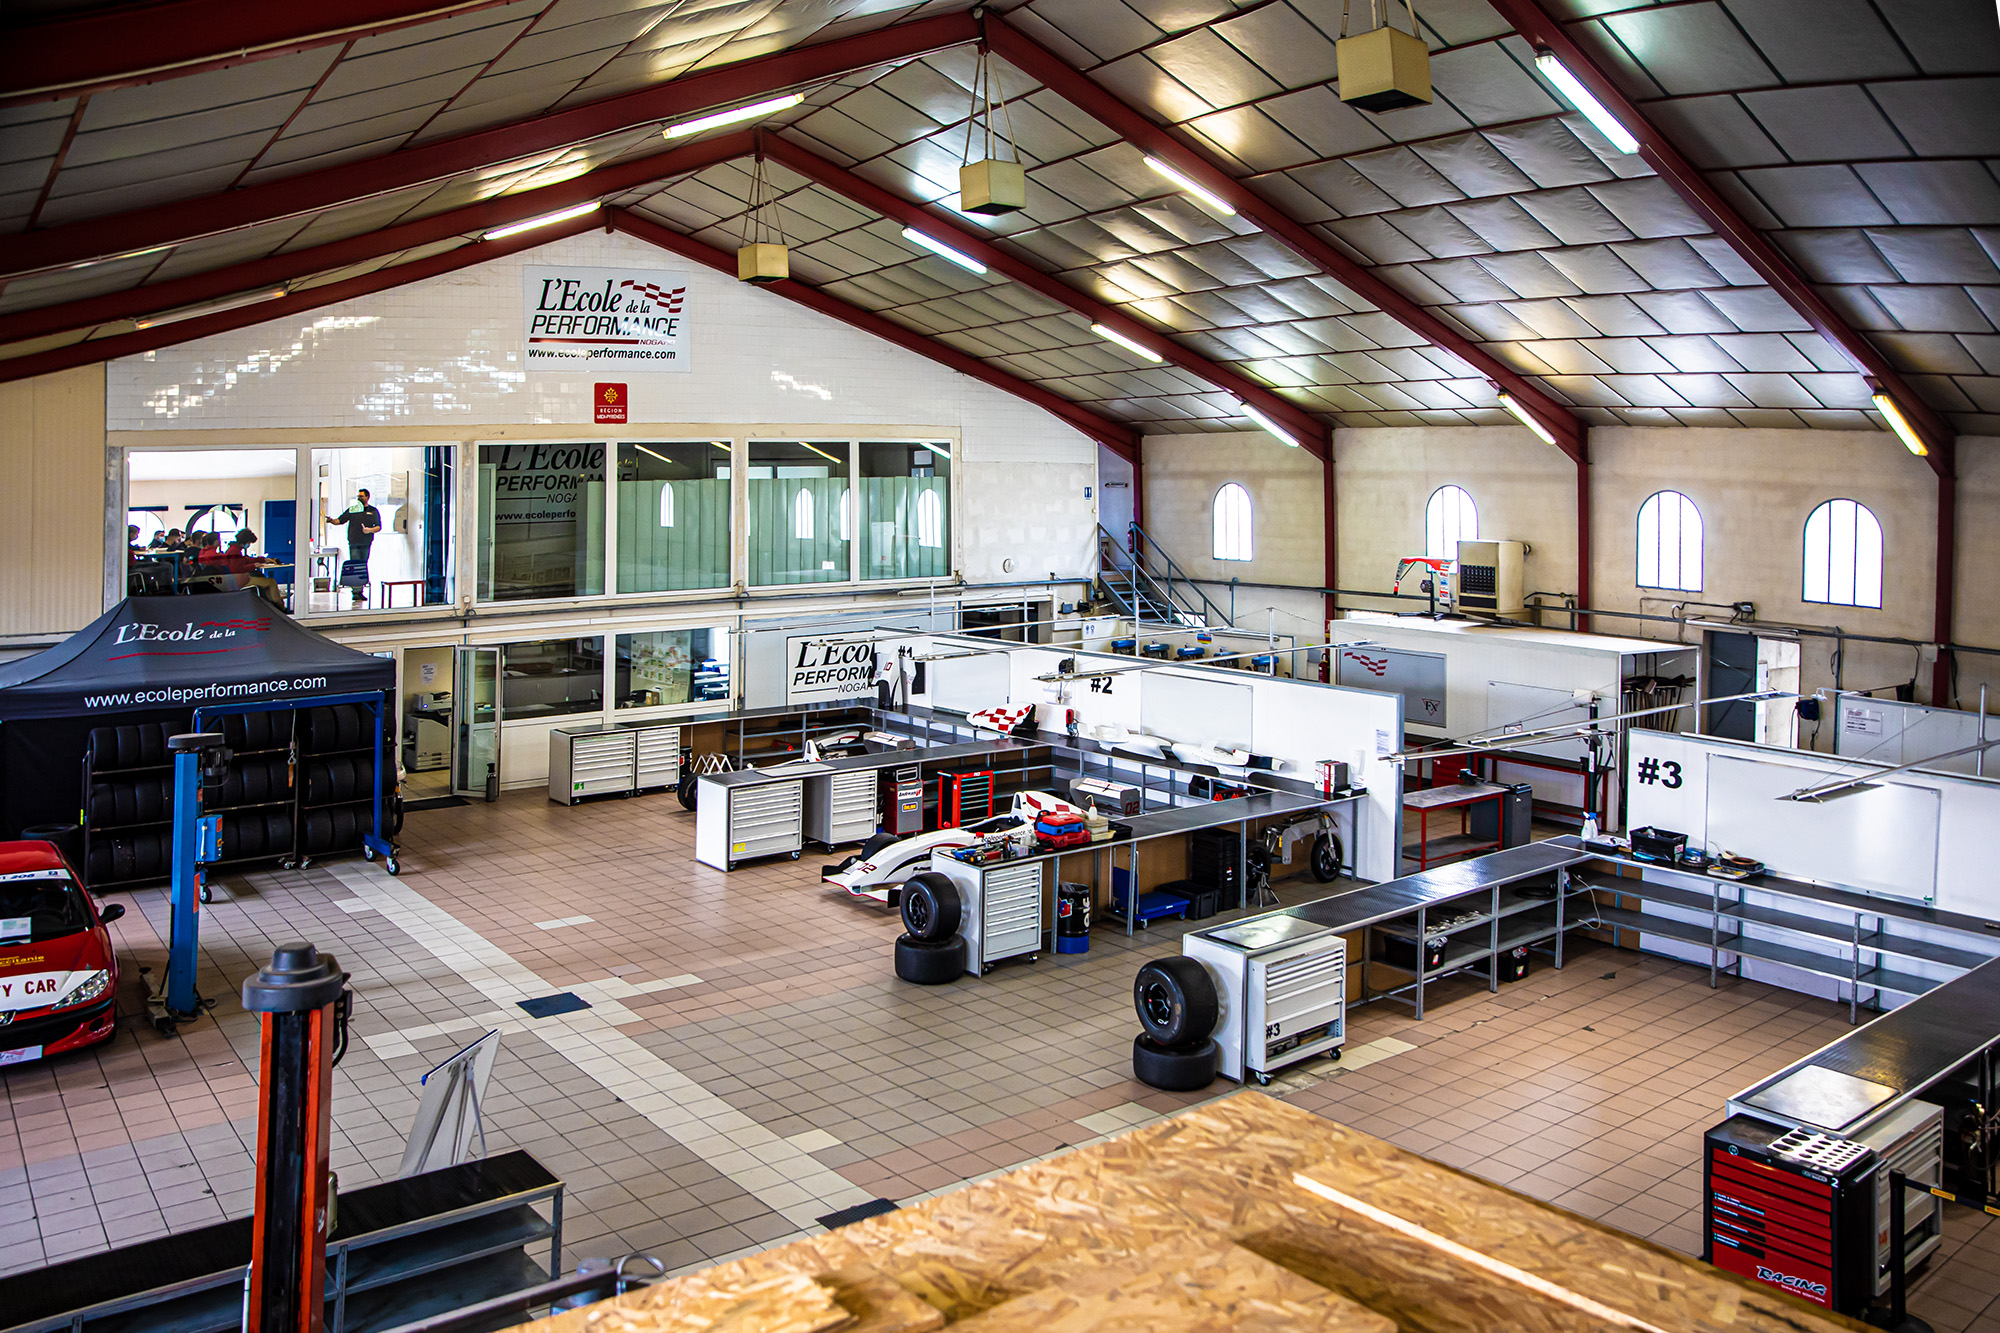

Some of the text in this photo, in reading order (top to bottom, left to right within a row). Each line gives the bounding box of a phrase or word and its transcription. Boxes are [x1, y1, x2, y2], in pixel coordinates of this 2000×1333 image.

[536, 278, 651, 313] L'Ecole de la
[530, 314, 680, 337] PERFORMANCE
[528, 347, 676, 360] www.ecoleperformance.com
[112, 622, 236, 646] L'Ecole de la
[898, 645, 913, 658] #1
[793, 665, 873, 686] PERFORM
[84, 676, 327, 708] www.ecoleperformance.com
[1090, 676, 1113, 694] #2
[1637, 756, 1683, 789] #3
[573, 782, 585, 791] #1
[1125, 801, 1141, 815] 02
[732, 842, 747, 853] #2
[24, 979, 57, 995] CAR
[1265, 1022, 1281, 1039] #3
[1831, 1177, 1839, 1189] 2
[1756, 1265, 1827, 1296] RACING
